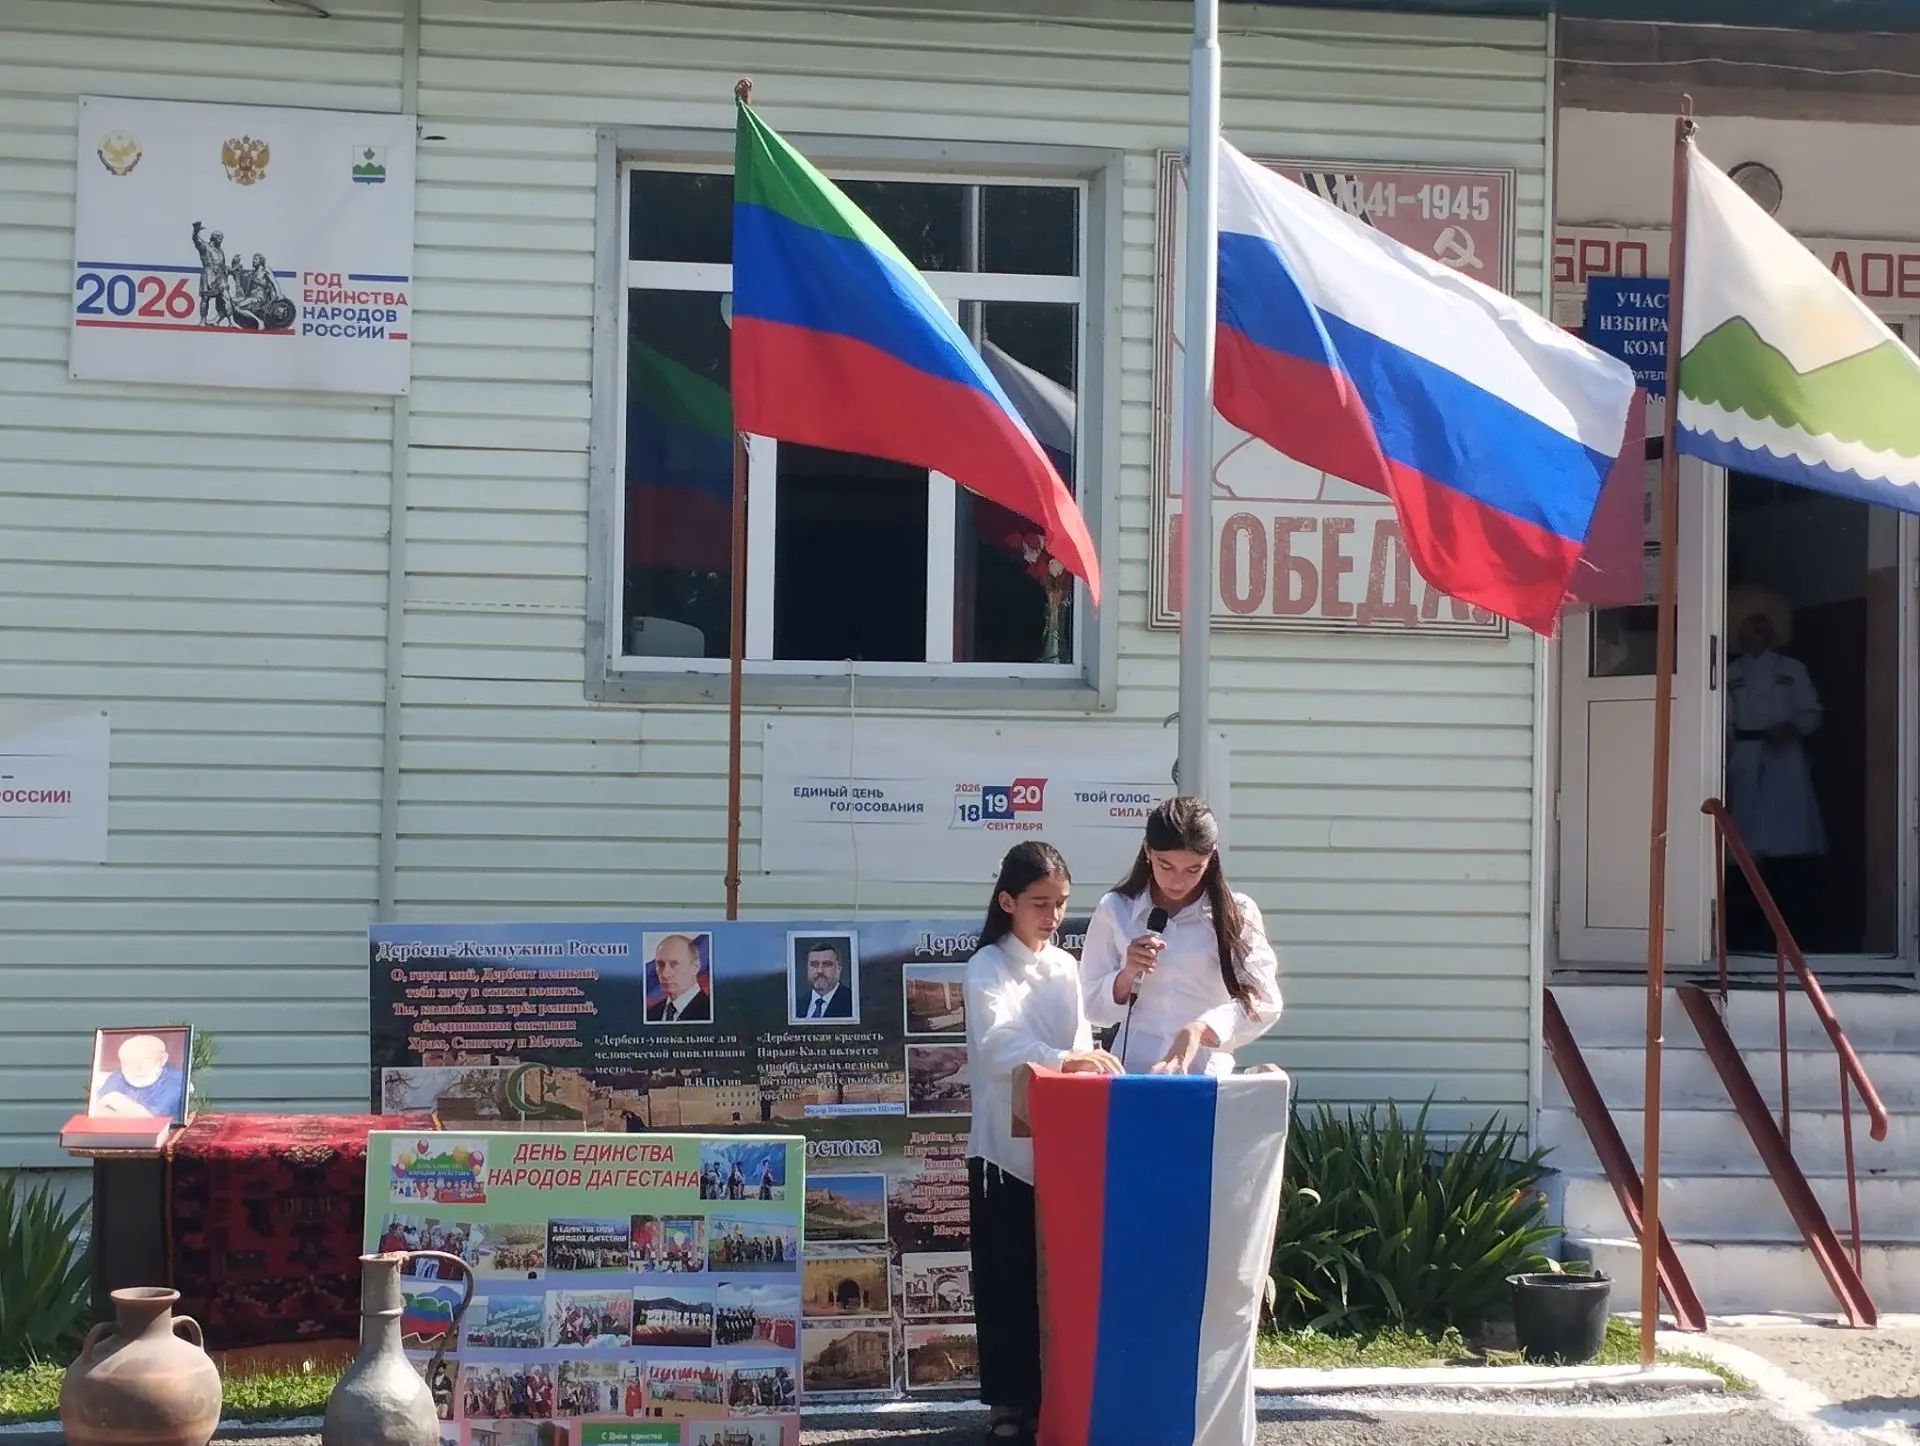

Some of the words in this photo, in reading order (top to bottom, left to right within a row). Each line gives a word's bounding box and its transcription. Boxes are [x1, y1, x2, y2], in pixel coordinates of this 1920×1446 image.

[303, 271, 342, 289] ГОД
[76, 272, 195, 319] 2026
[303, 289, 408, 306] ЕДИНСТВА
[1616, 291, 1668, 309] УЧАС
[302, 306, 398, 324] НАРОДОВ
[1600, 314, 1669, 332] ИЗБИРА
[302, 323, 385, 340] РОССИИ
[1623, 339, 1665, 356] КОМ
[0, 789, 71, 803] ОССИИ!
[793, 785, 848, 799] ЕДИНЫЙ
[851, 788, 884, 800] ДЕНЬ
[955, 783, 981, 793] 2026
[959, 804, 980, 822] 18
[985, 794, 1008, 814] 19
[1011, 784, 1041, 804] 20
[1074, 790, 1107, 803] ТВОЙ
[1110, 793, 1151, 804] ГОЛОС
[830, 801, 924, 813] ГОЛОСОВАНИЯ
[1109, 807, 1144, 817] СИЛА
[987, 821, 1044, 832] СЕНТЯБРЯ
[567, 939, 630, 957] России
[513, 1143, 567, 1165] ДЕНЬ
[572, 1144, 674, 1166] ЕДИНСТВА
[806, 1138, 883, 1157] остока
[487, 1168, 582, 1191] НАРОДОВ
[586, 1169, 700, 1191] ДАГЕСТАНА
